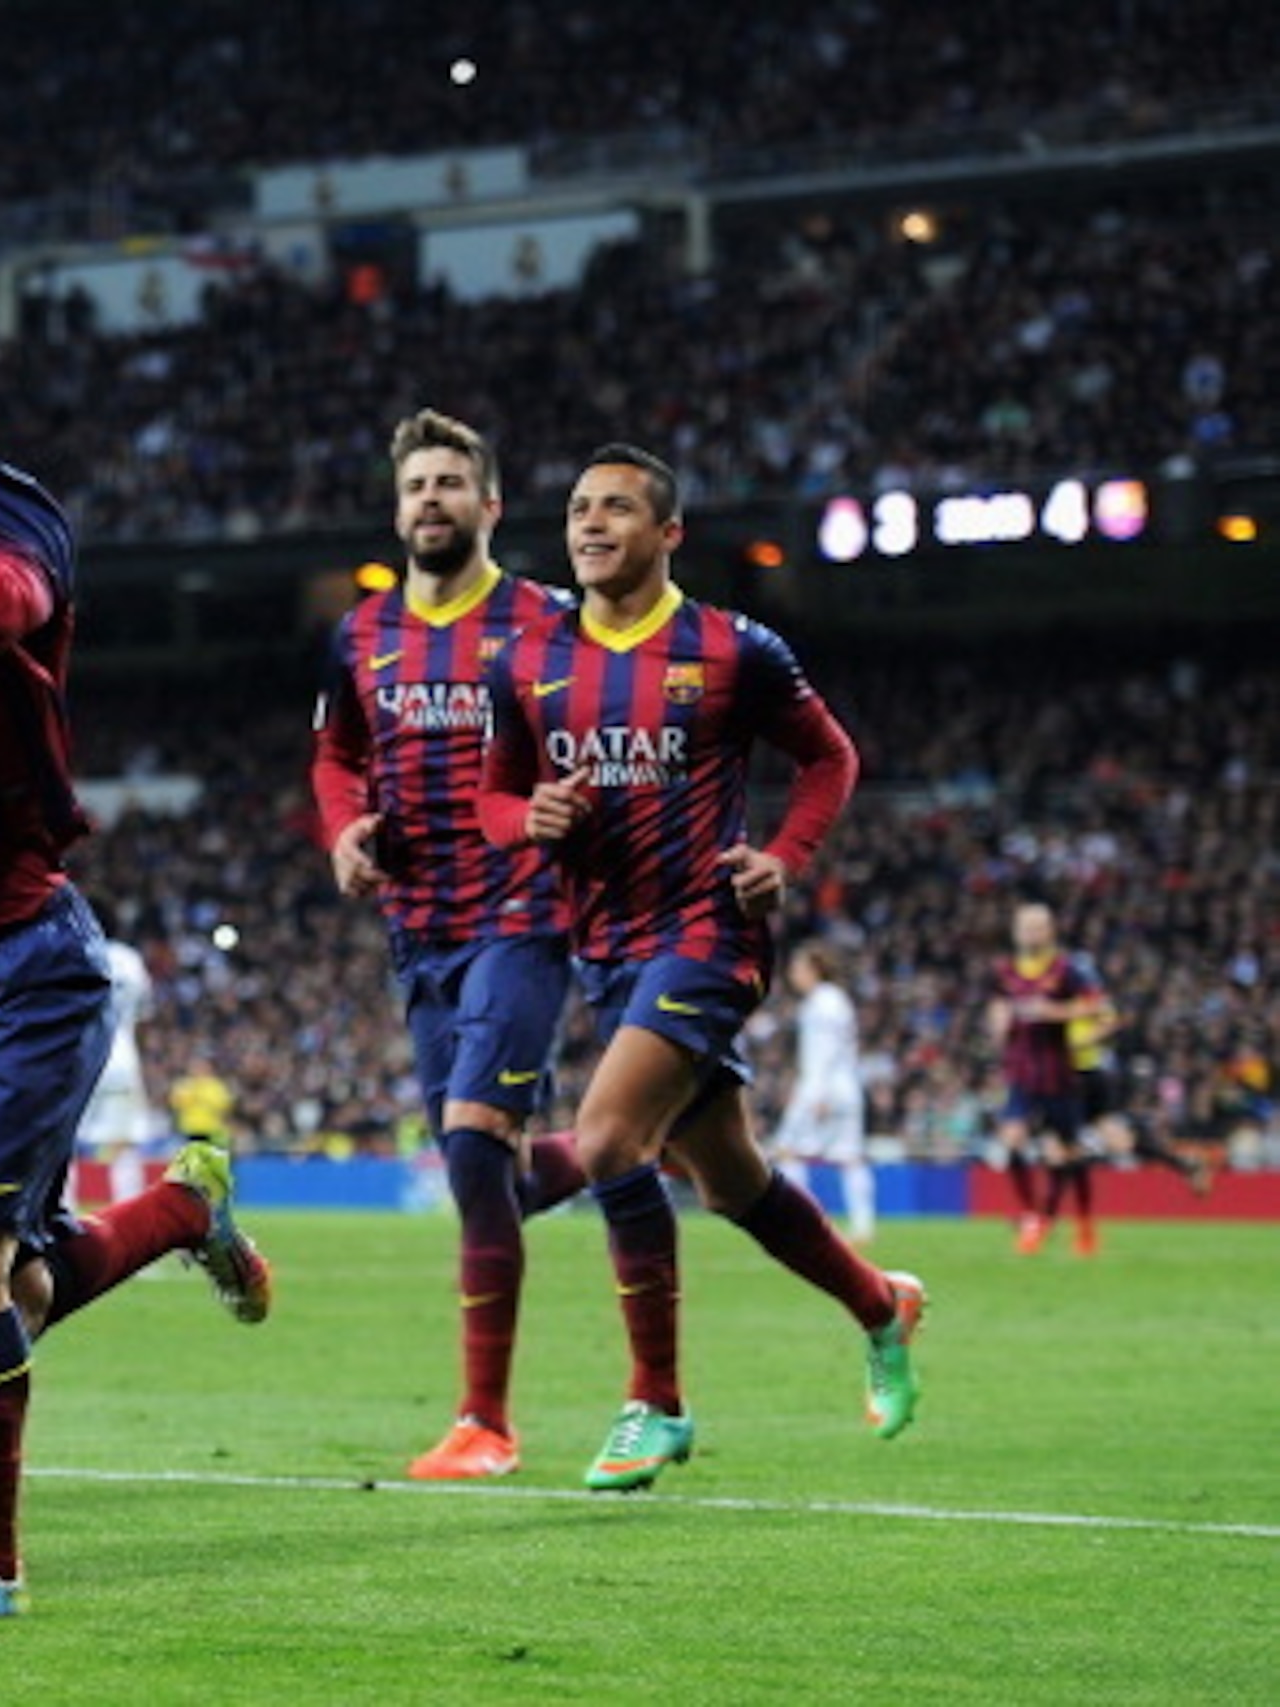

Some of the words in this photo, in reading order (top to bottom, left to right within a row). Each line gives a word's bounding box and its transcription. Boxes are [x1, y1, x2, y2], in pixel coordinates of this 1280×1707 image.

[873, 491, 917, 555] 3
[1042, 480, 1089, 543] 4
[546, 726, 688, 768] QATAR
